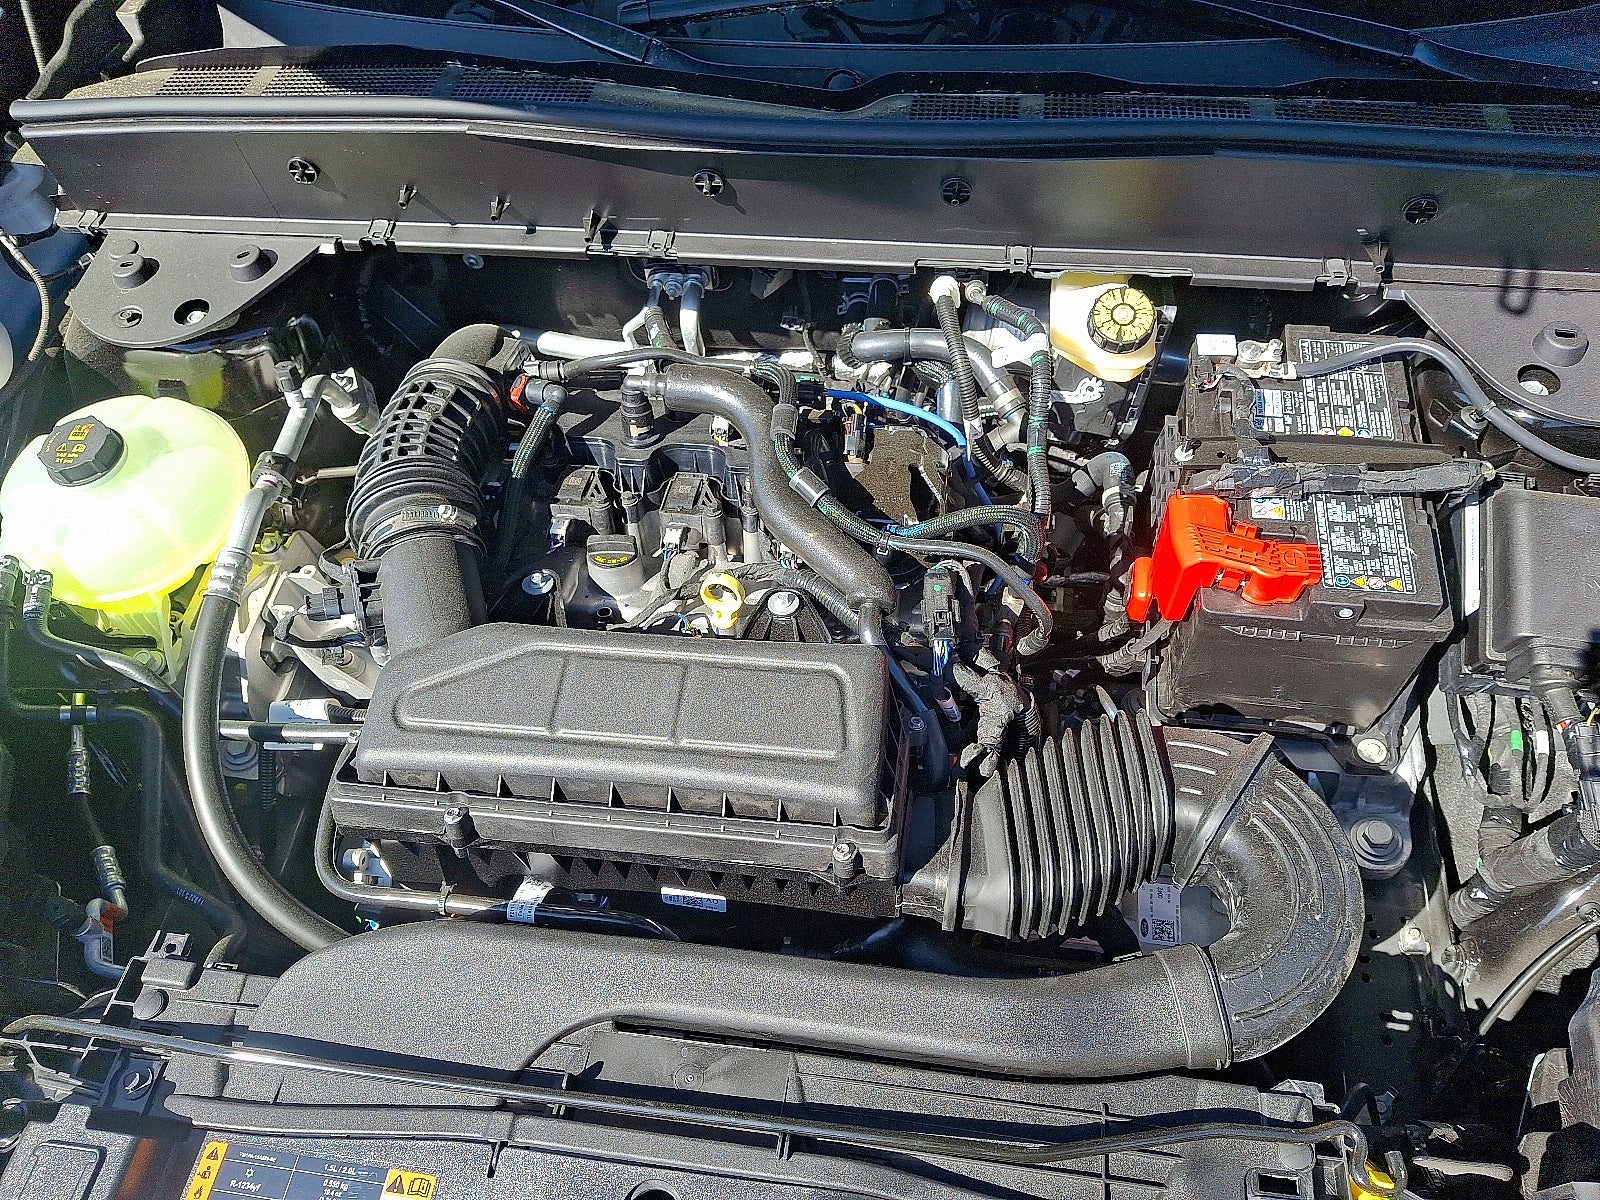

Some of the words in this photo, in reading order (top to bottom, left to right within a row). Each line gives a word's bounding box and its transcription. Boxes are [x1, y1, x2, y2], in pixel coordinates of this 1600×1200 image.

[324, 1164, 337, 1172] 1.5L
[229, 1180, 262, 1192] R-1234yf
[338, 1182, 349, 1192] kg
